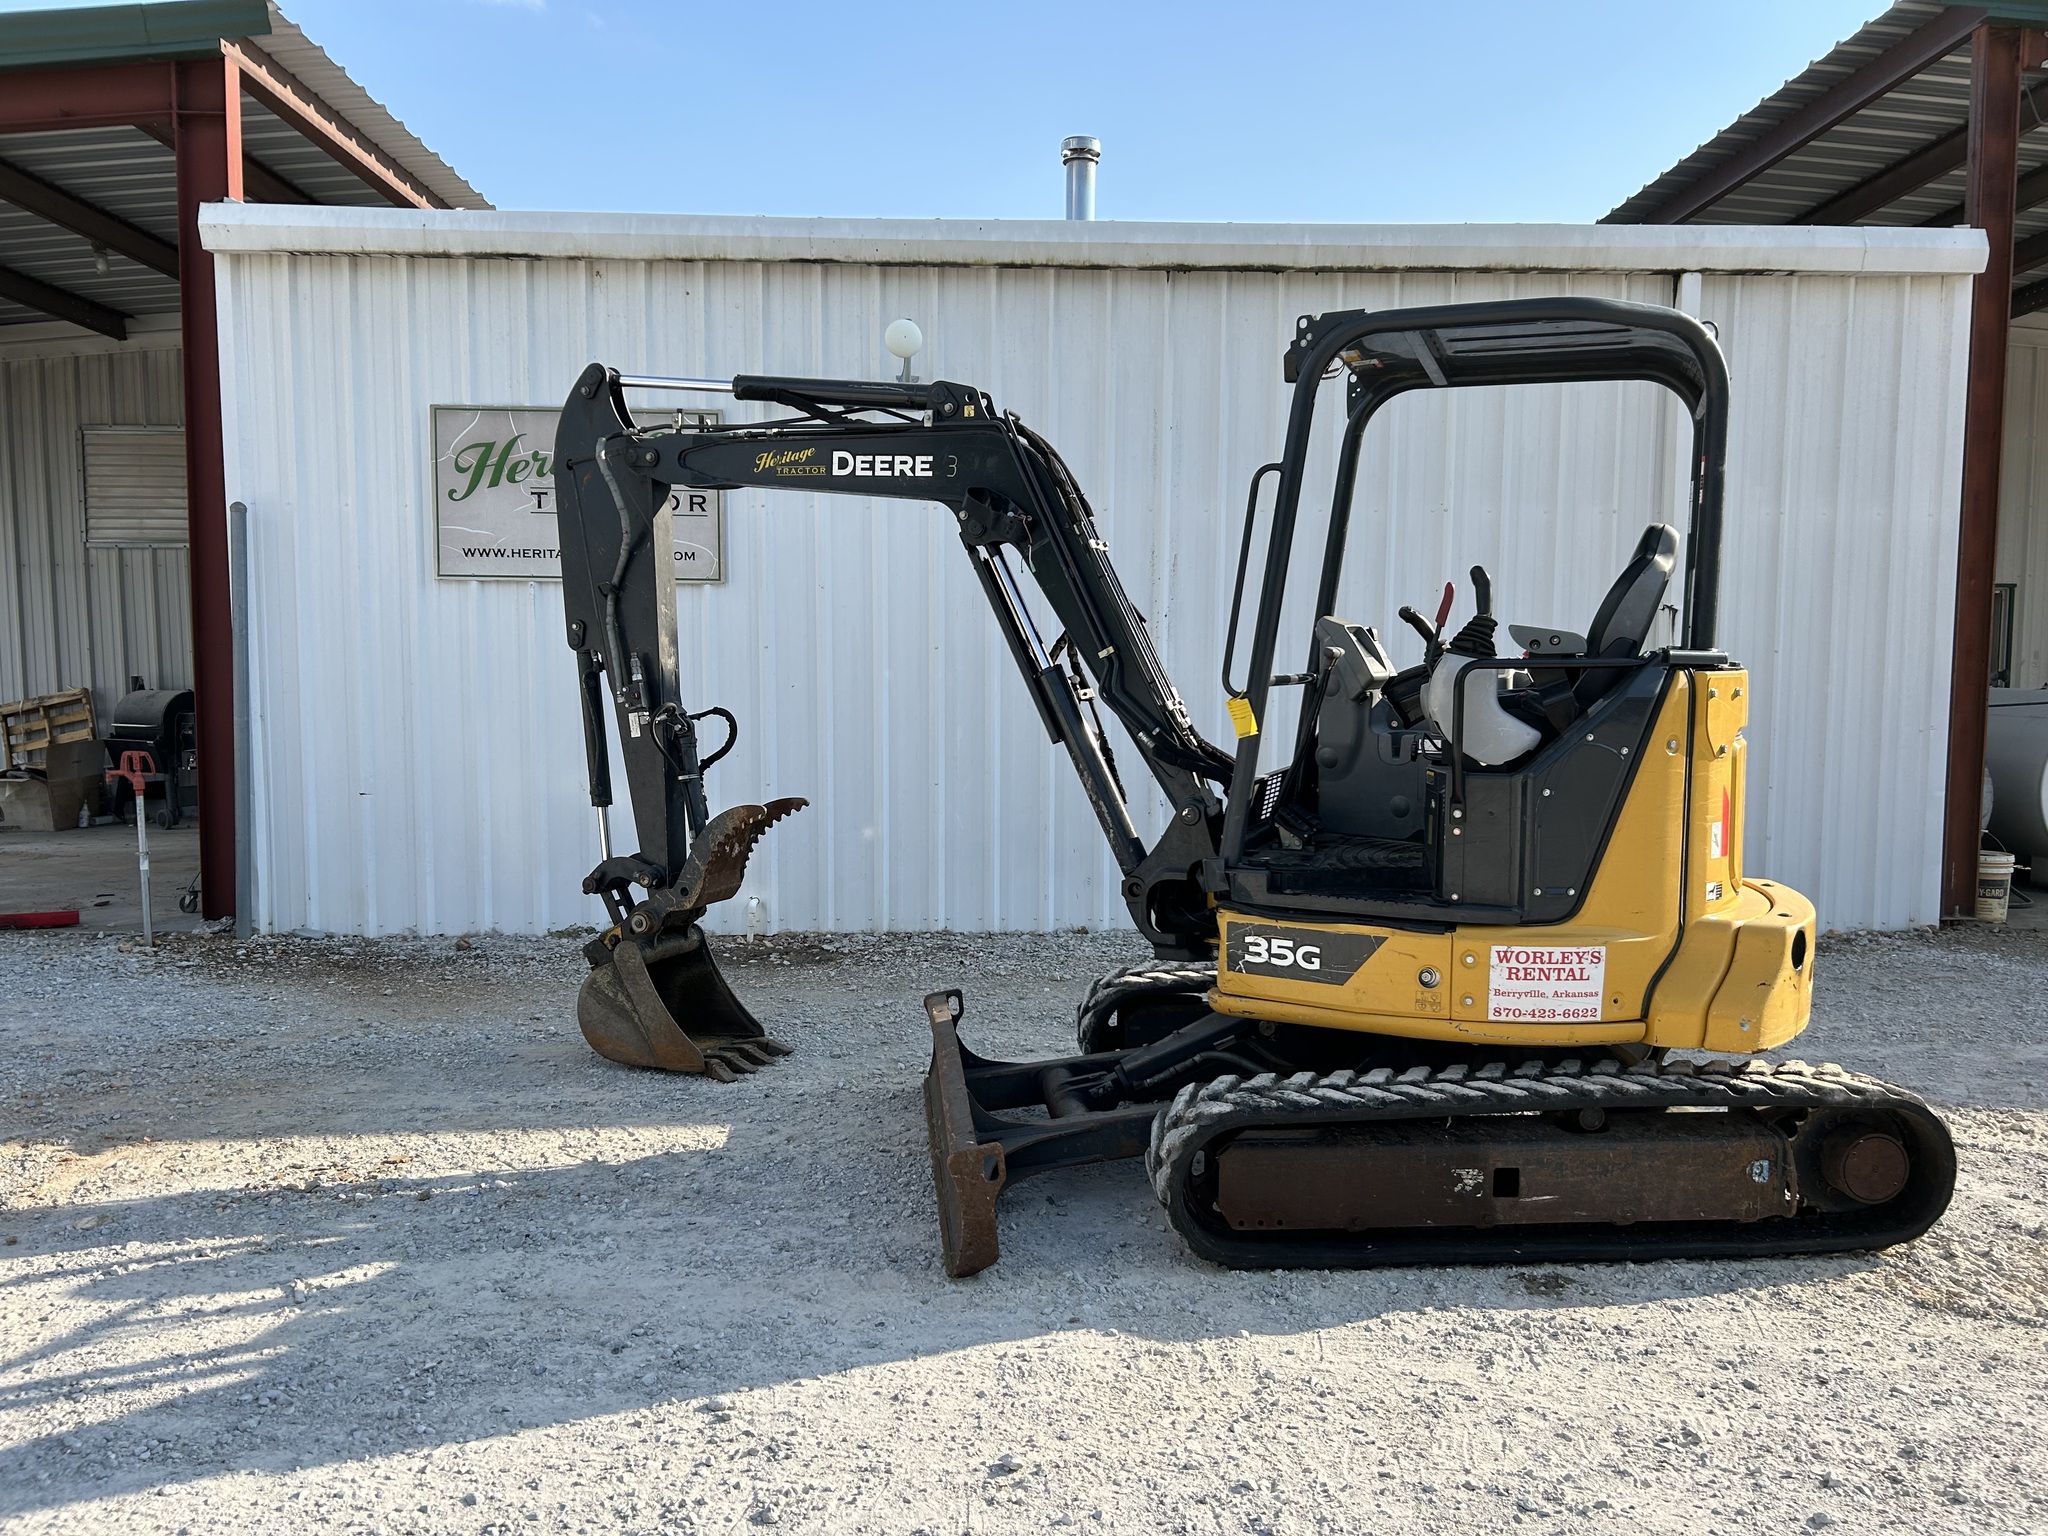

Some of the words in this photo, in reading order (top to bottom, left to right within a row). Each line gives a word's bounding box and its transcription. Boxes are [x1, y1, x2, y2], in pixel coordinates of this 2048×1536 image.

[754, 447, 816, 473] Heritage
[832, 451, 933, 477] DEERE
[776, 466, 826, 475] TRACTOR
[1244, 936, 1321, 970] 35G
[1496, 951, 1602, 965] WORLEY'S
[1506, 967, 1590, 981] RENTAL
[1493, 989, 1549, 999] Berryville,
[1552, 990, 1599, 998] Arkansas
[1493, 1007, 1598, 1018] 870-423-6622
